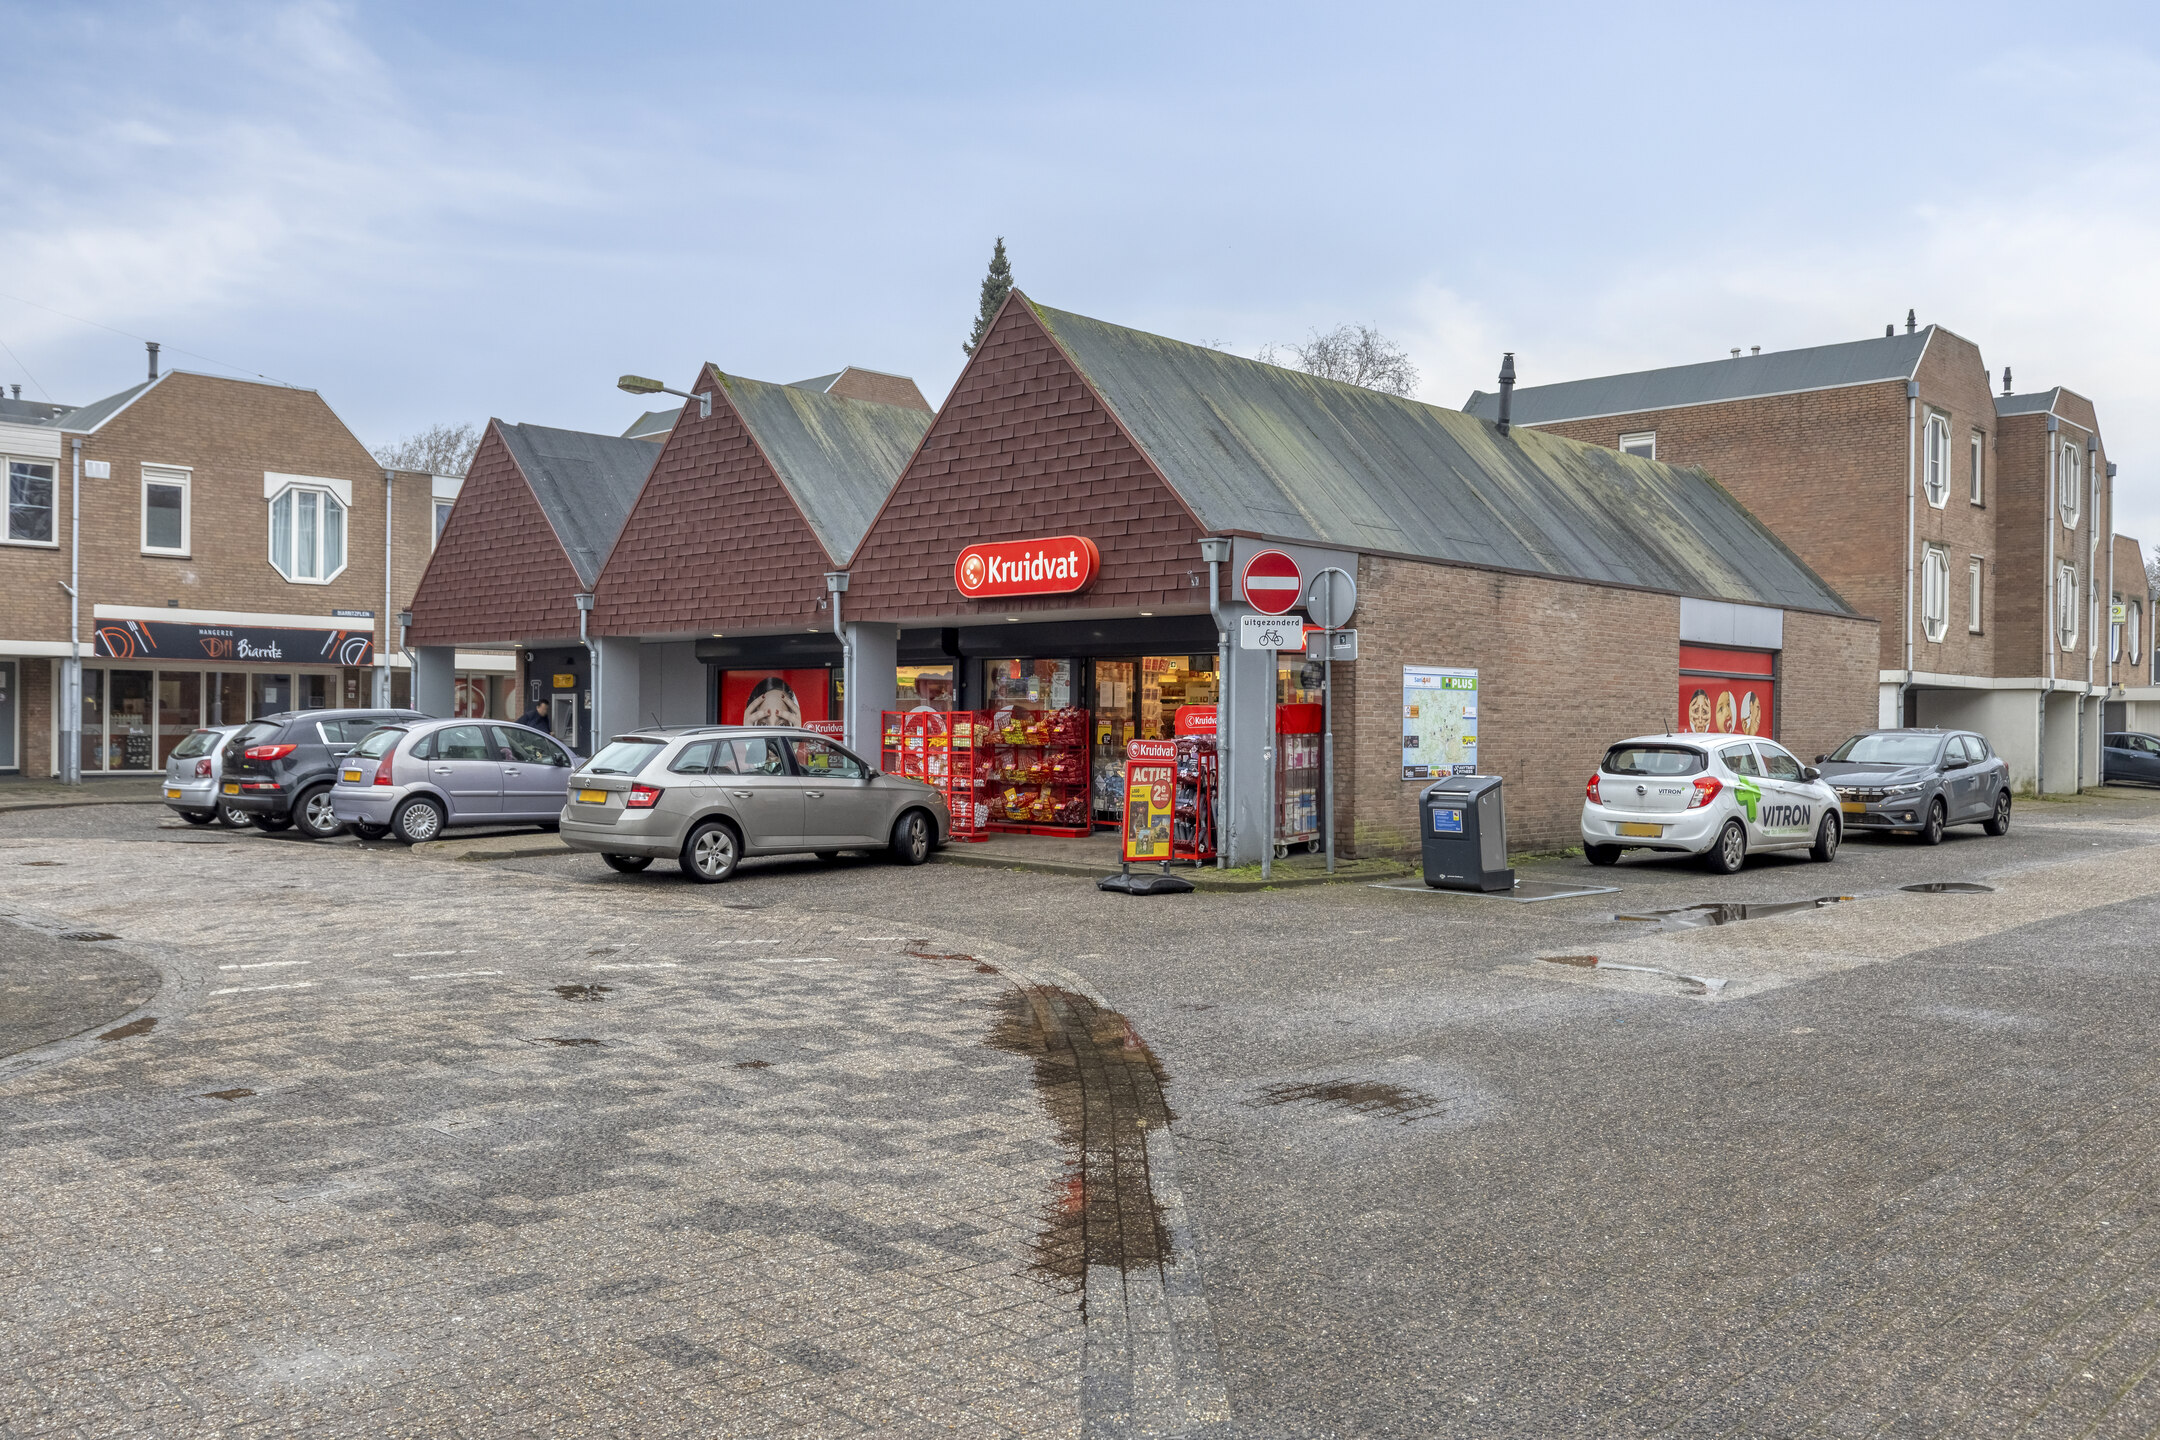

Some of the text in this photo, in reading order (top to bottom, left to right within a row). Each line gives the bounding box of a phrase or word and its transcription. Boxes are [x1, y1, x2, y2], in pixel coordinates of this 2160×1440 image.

[988, 550, 1078, 584] Kruidvat
[1244, 619, 1300, 628] uitgezonderd
[198, 629, 234, 637] MANGERIE
[237, 638, 283, 659] Biarritz
[1451, 679, 1473, 689] PLUS
[815, 724, 843, 733] Kruidva
[1140, 744, 1174, 757] Kruidvat
[1132, 766, 1171, 783] ACTIE!
[1762, 804, 1811, 828] VITRON
